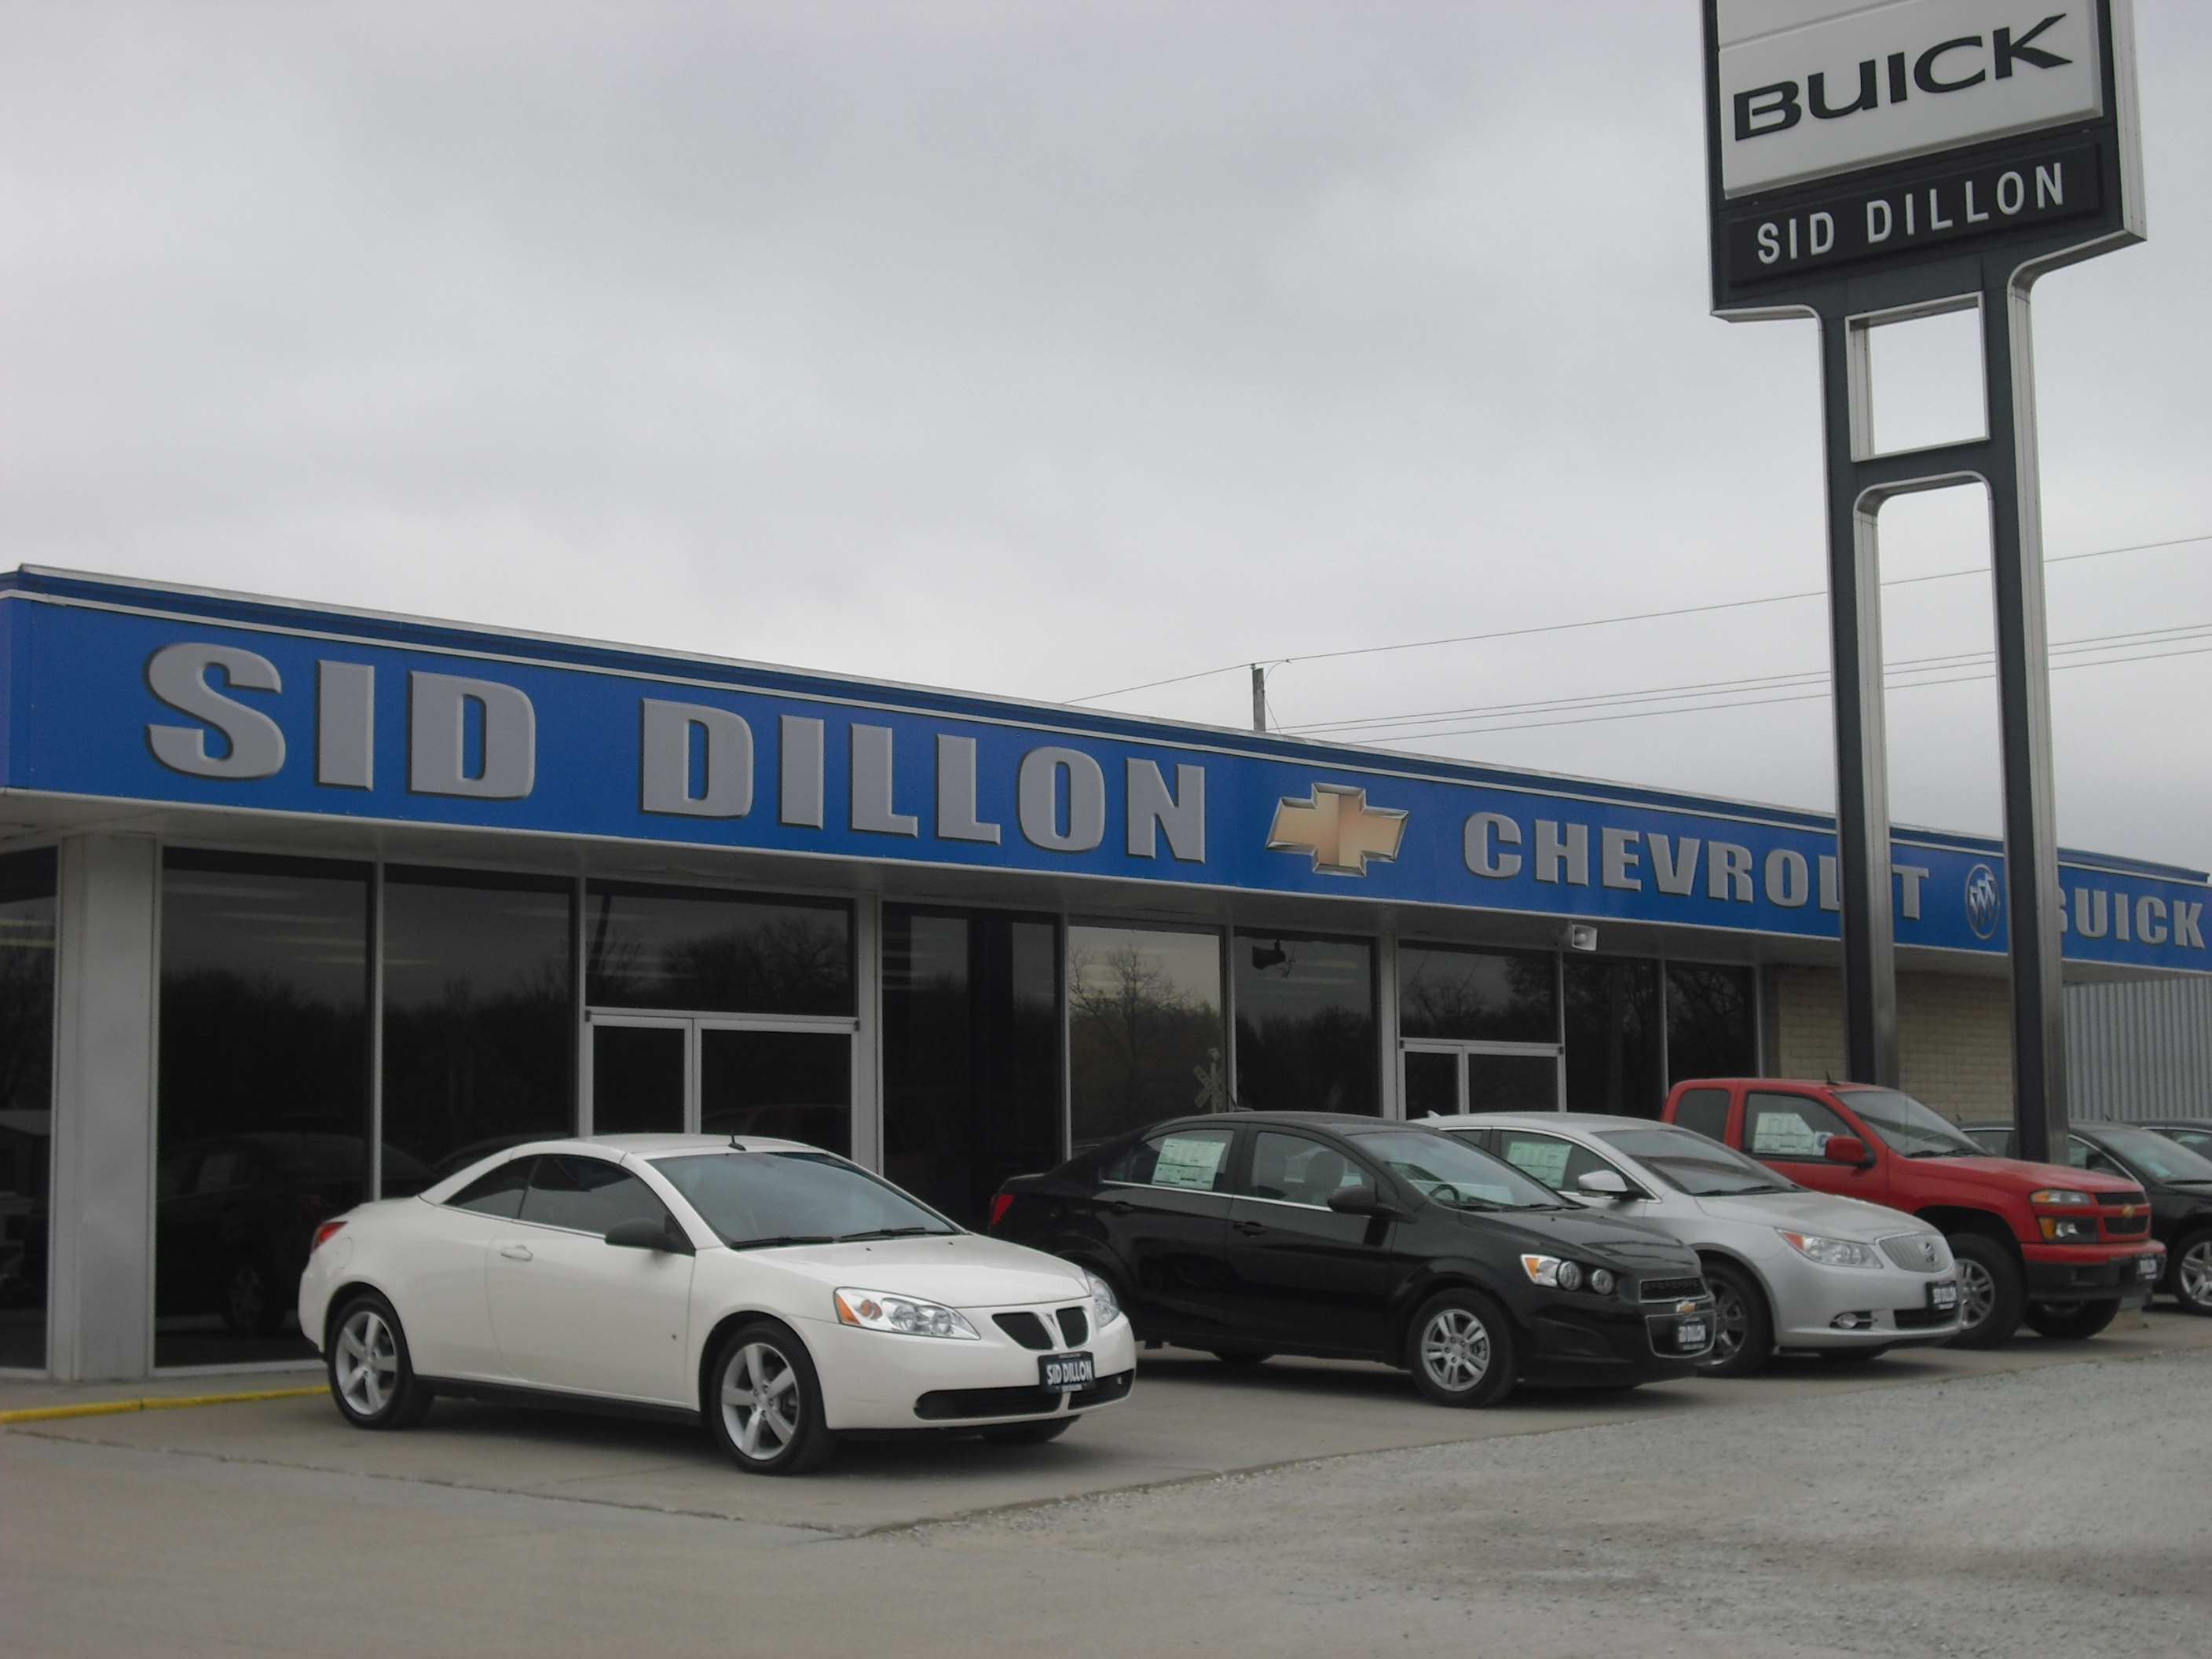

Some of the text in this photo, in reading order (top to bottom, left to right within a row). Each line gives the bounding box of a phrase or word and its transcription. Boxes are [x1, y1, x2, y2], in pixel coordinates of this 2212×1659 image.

[1733, 13, 2073, 141] BUICK
[1756, 162, 2064, 266] SID DILLON
[143, 641, 2206, 950] SID DILLON CHEVROLT UICK
[1046, 1361, 1093, 1386] SID DILLON
